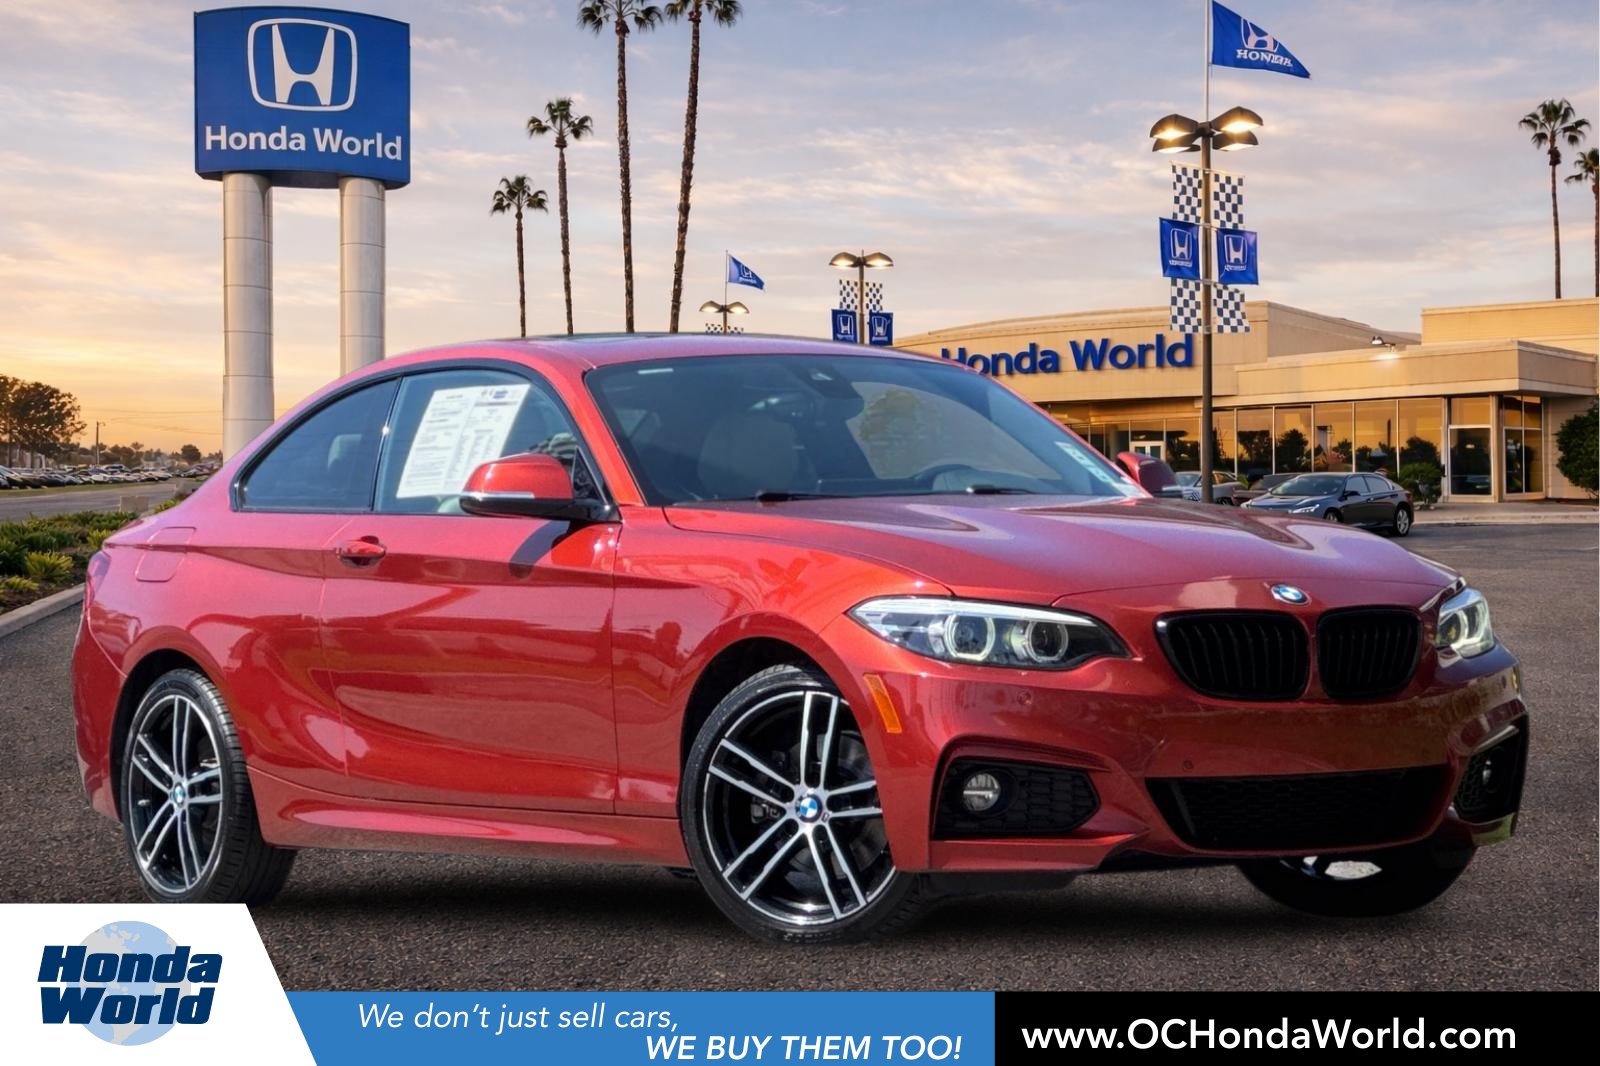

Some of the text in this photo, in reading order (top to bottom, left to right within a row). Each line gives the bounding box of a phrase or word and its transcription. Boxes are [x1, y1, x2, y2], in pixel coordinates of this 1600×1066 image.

[205, 125, 402, 160] Honda World
[1070, 334, 1193, 370] World
